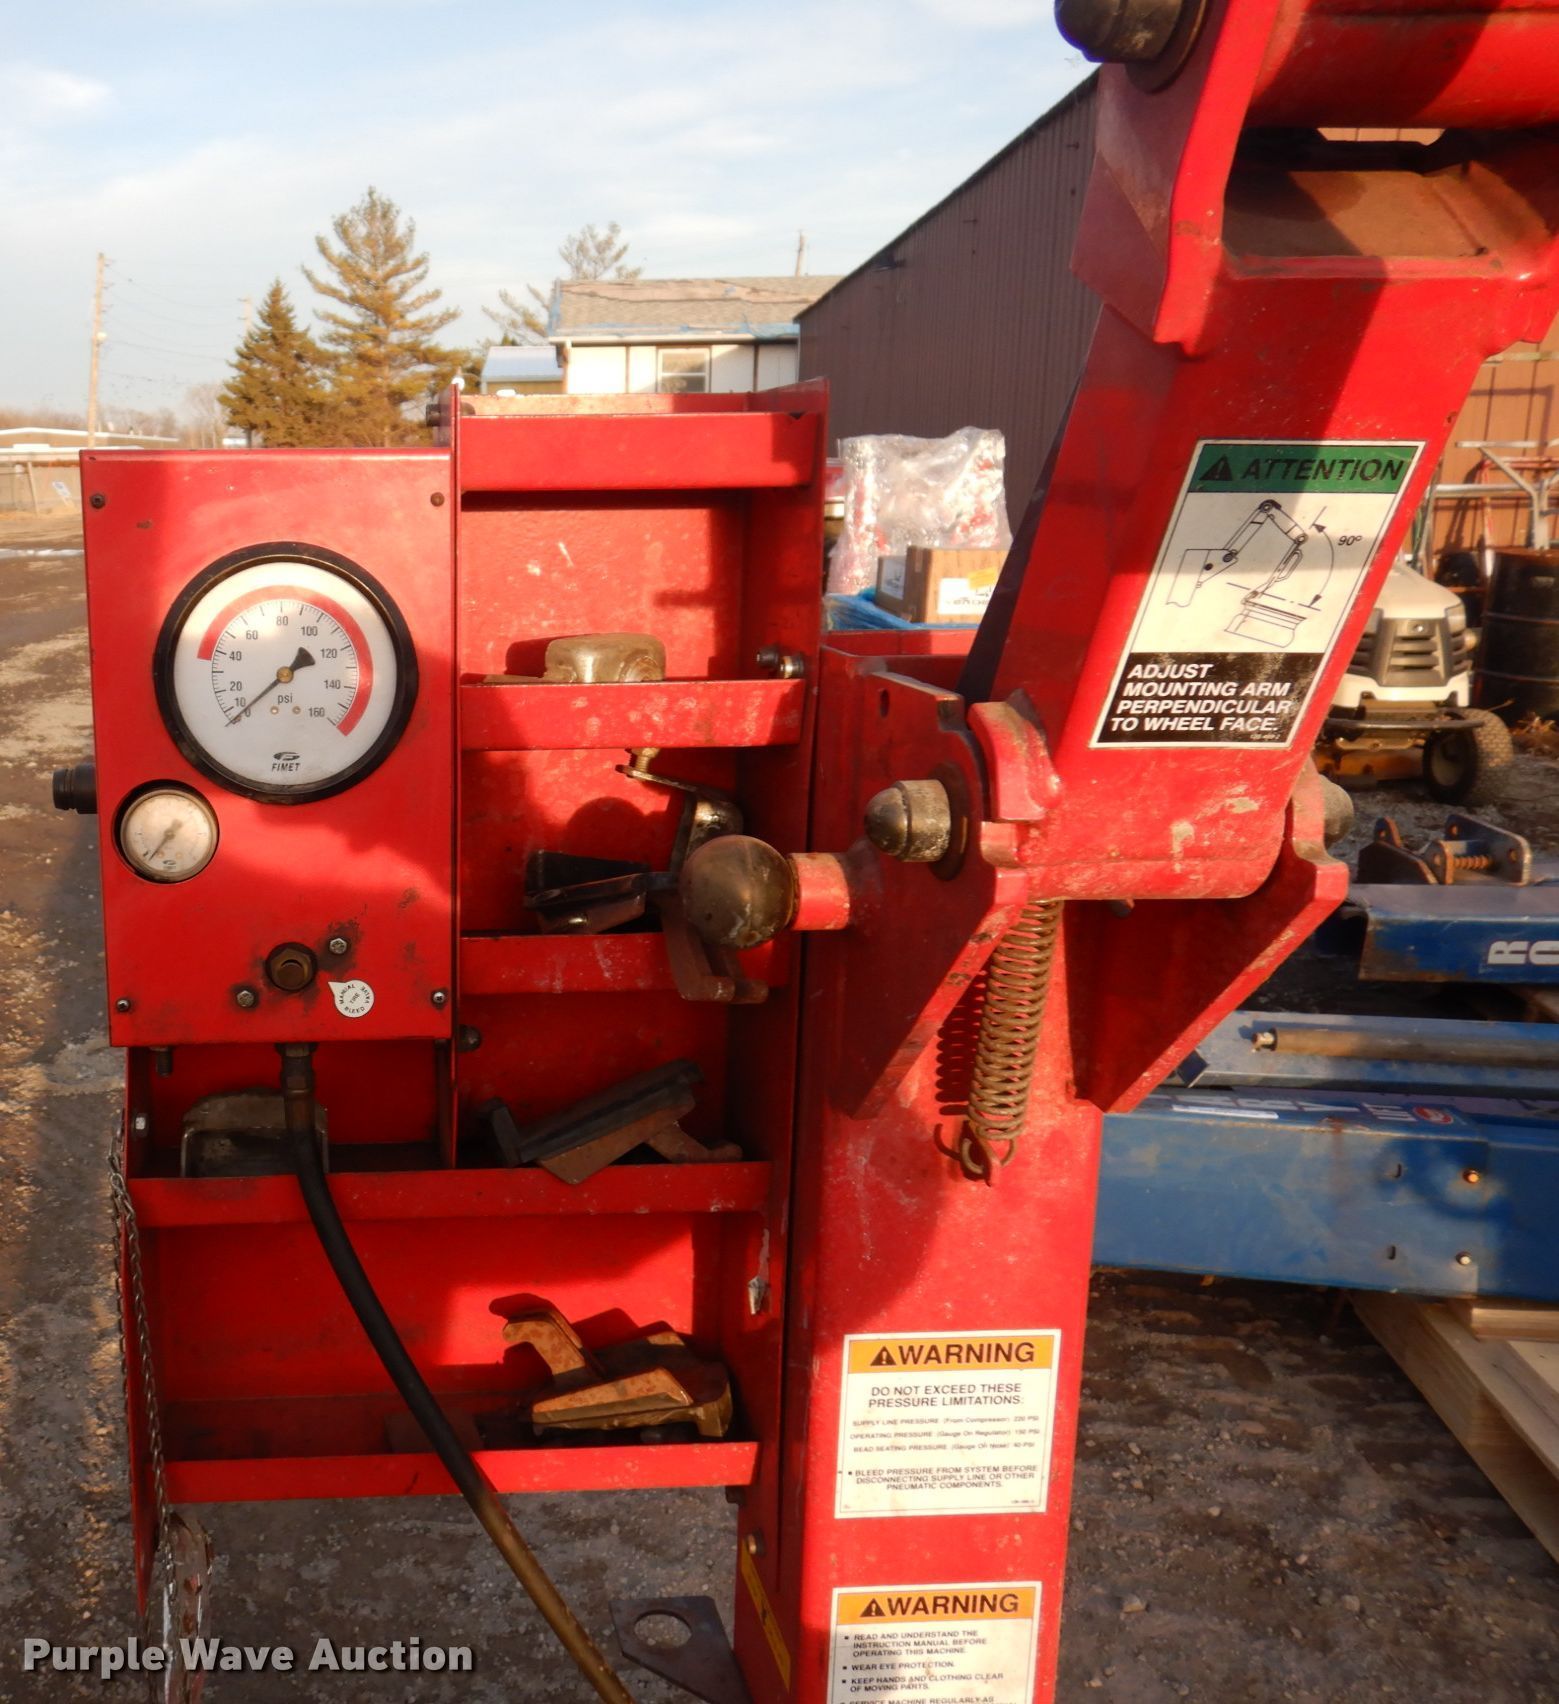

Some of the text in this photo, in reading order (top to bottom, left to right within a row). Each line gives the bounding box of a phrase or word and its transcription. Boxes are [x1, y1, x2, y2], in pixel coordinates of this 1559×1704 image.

[1241, 459, 1404, 480] ATTENTION
[276, 616, 289, 626] 80
[246, 630, 258, 640] 60
[300, 626, 318, 636] 100
[229, 651, 242, 661] 40
[321, 648, 338, 659] 120
[1127, 664, 1214, 679] ADJUST
[230, 681, 242, 692] 20
[324, 680, 340, 690] 140
[1123, 682, 1292, 697] MOUNTING ARM
[234, 698, 246, 708] 10
[277, 692, 293, 706] psi
[1116, 700, 1292, 714] PERPENDICULAR
[308, 708, 325, 718] 160
[1111, 717, 1279, 731] TO WHEEL FACE.
[271, 763, 301, 772] FIMET
[339, 984, 355, 1004] MANUAL
[898, 1342, 1035, 1365] WARNING
[871, 1383, 1022, 1396] DO NOT EXCEED THESE
[868, 1398, 937, 1408] PRESSURE
[856, 1476, 928, 1484] DISCONNECTING
[939, 1481, 1002, 1489] COMPONENTS.
[887, 1593, 1019, 1616] WARNING
[854, 1641, 911, 1649] INSTRUCTION
[853, 1649, 902, 1657] OPERATING
